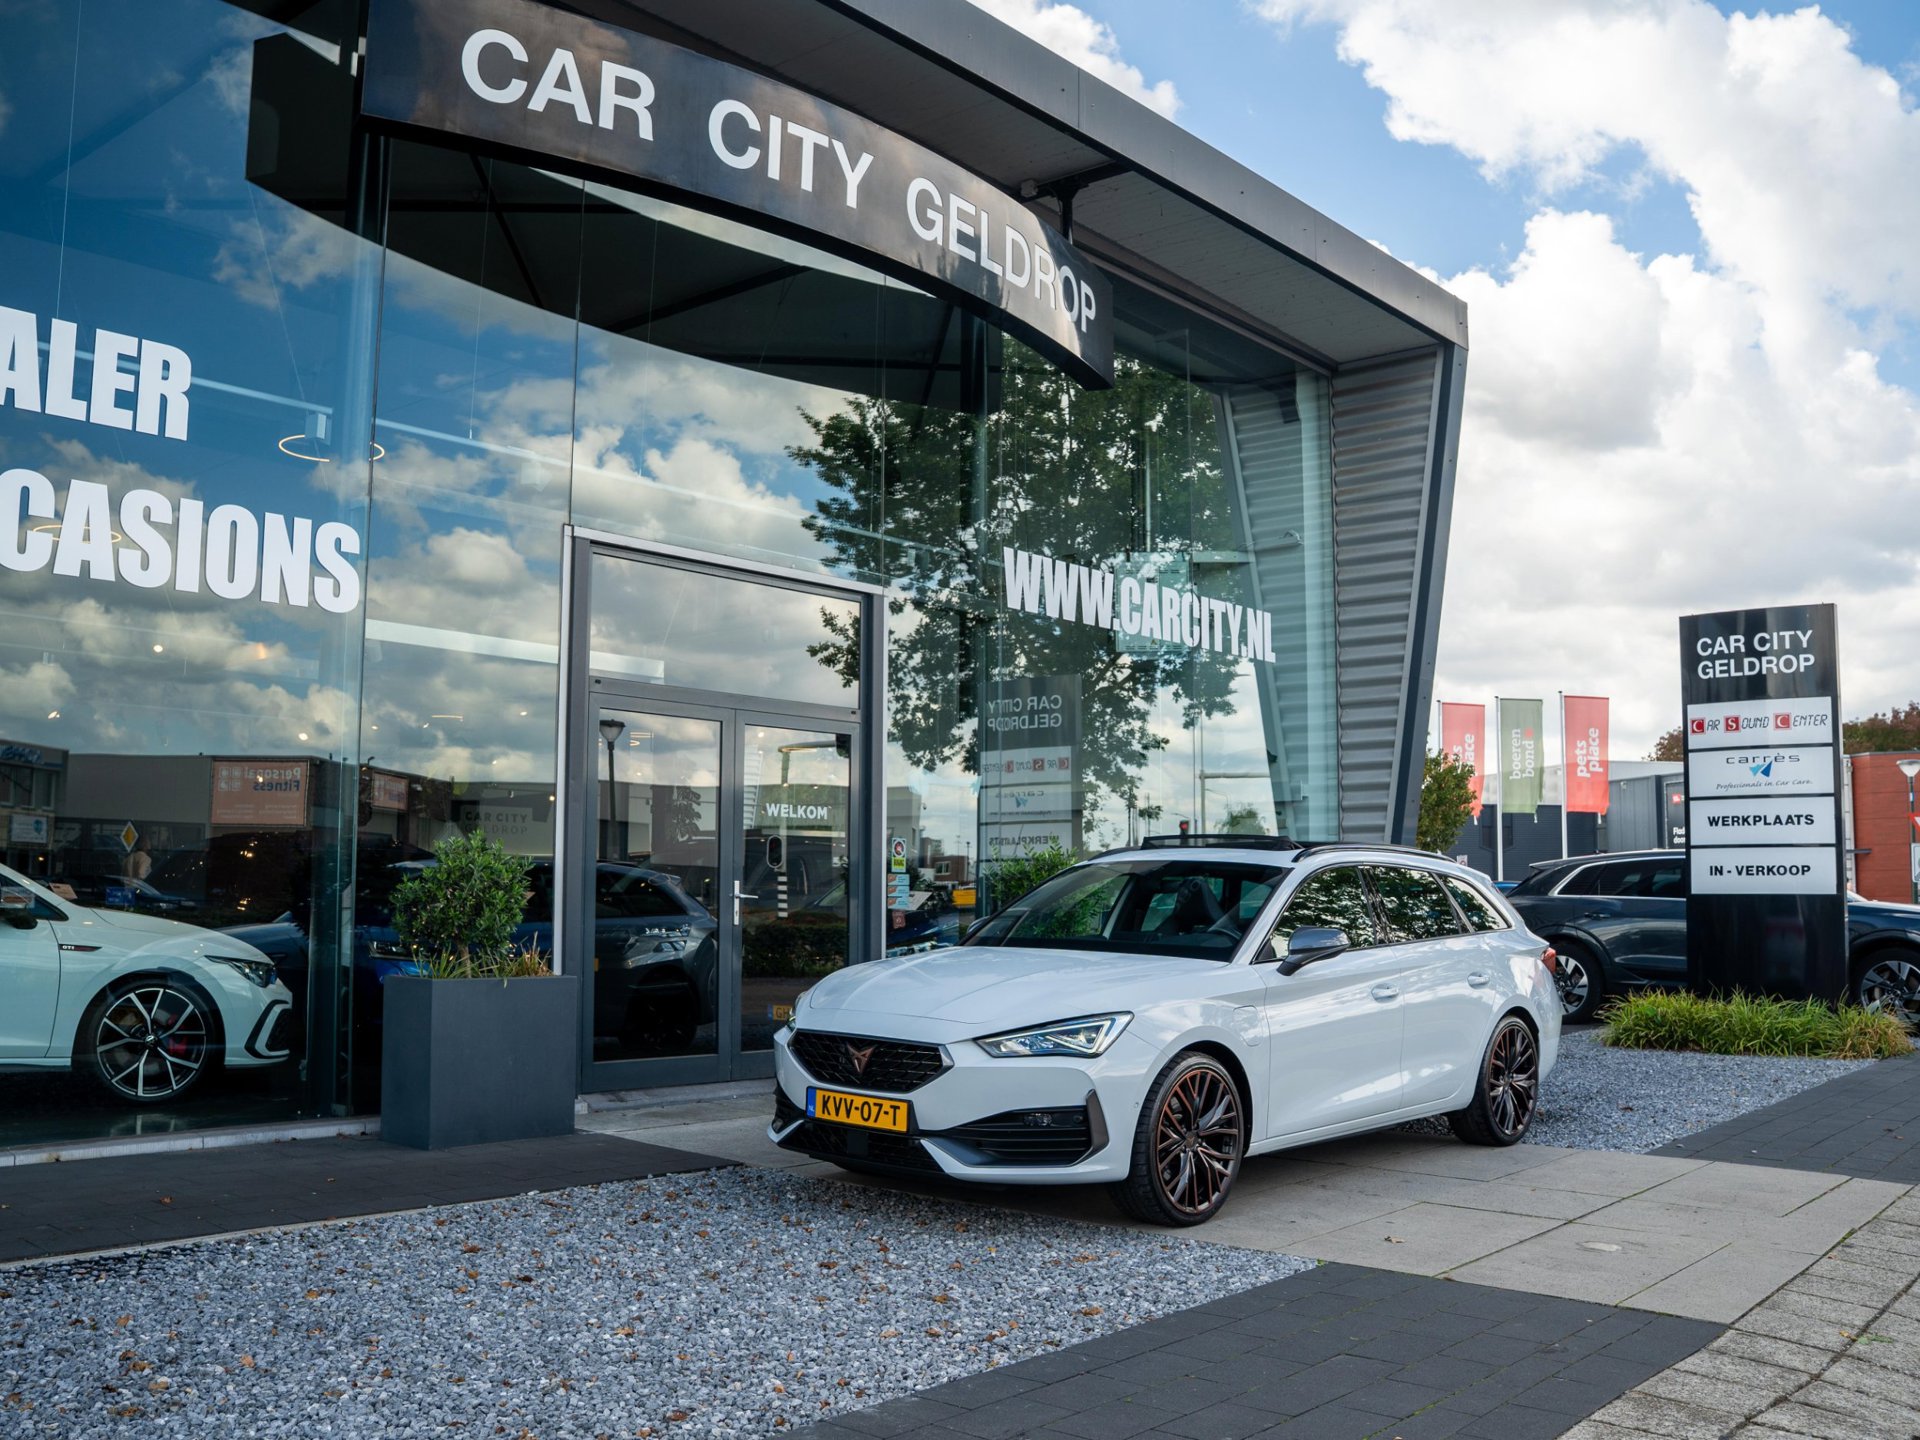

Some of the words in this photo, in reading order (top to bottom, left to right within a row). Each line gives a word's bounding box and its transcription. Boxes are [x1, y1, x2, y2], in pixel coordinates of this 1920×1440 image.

[461, 28, 655, 142] CAR
[708, 99, 874, 209] CITY
[906, 177, 1097, 334] GELDROP
[0, 305, 192, 441] ALER
[0, 468, 361, 613] CASIONS
[1003, 546, 1276, 663] WWW.CARCITY.NL
[1696, 634, 1745, 656] CAR
[1753, 629, 1813, 651] CITY
[1697, 653, 1815, 680] GELDROP
[1691, 718, 1721, 734] CAR
[1725, 715, 1770, 732] SOUND
[1774, 713, 1828, 730] CENTER
[1509, 728, 1522, 780] boeren
[1522, 740, 1535, 778] bond
[1574, 740, 1591, 778] pets
[1588, 727, 1603, 773] place
[1726, 752, 1801, 765] carrès
[496, 813, 528, 823] CITY
[766, 803, 828, 820] WELKOM
[1707, 814, 1814, 827] WERKPLAATS
[465, 823, 528, 834] GLDROP
[822, 1094, 900, 1126] KVV-07-T
